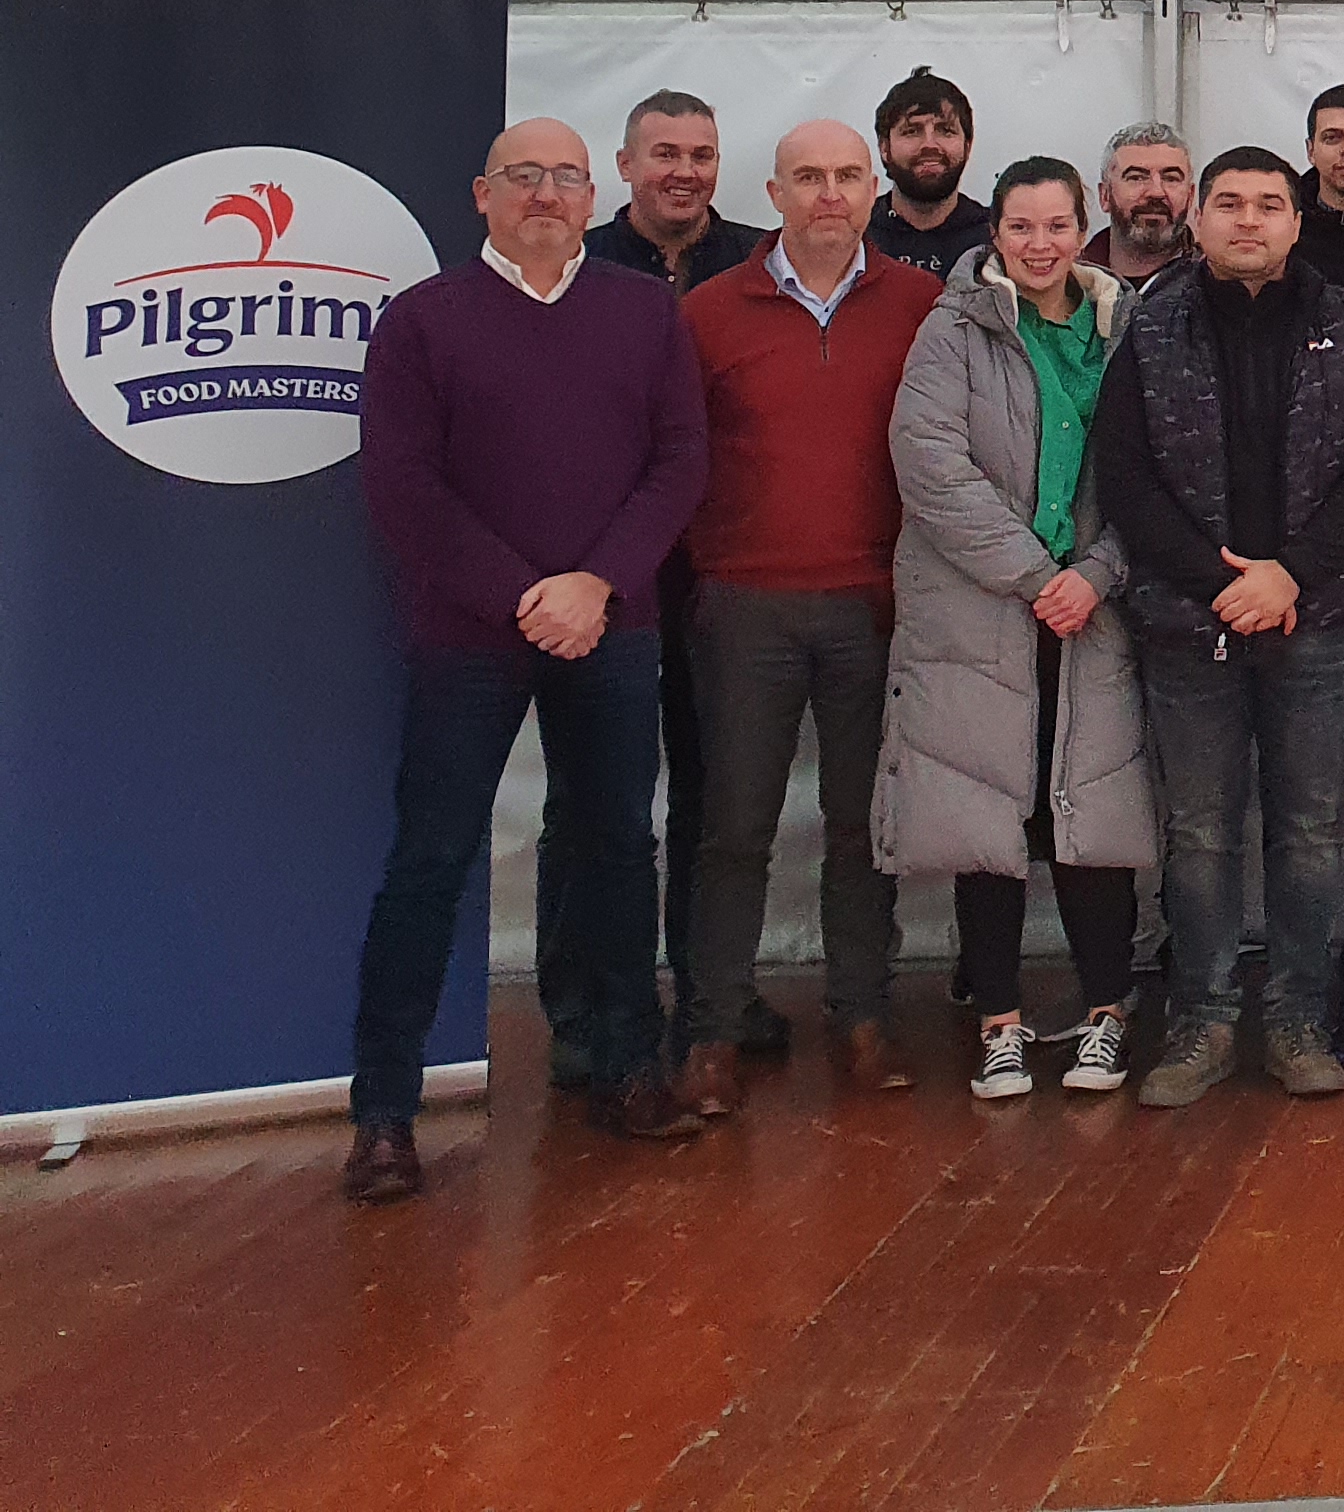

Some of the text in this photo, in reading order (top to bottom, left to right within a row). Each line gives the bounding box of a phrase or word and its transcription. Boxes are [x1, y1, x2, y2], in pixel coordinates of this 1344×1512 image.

[85, 280, 391, 358] Pilgrim'
[140, 377, 360, 410] FOOD MASTERS
